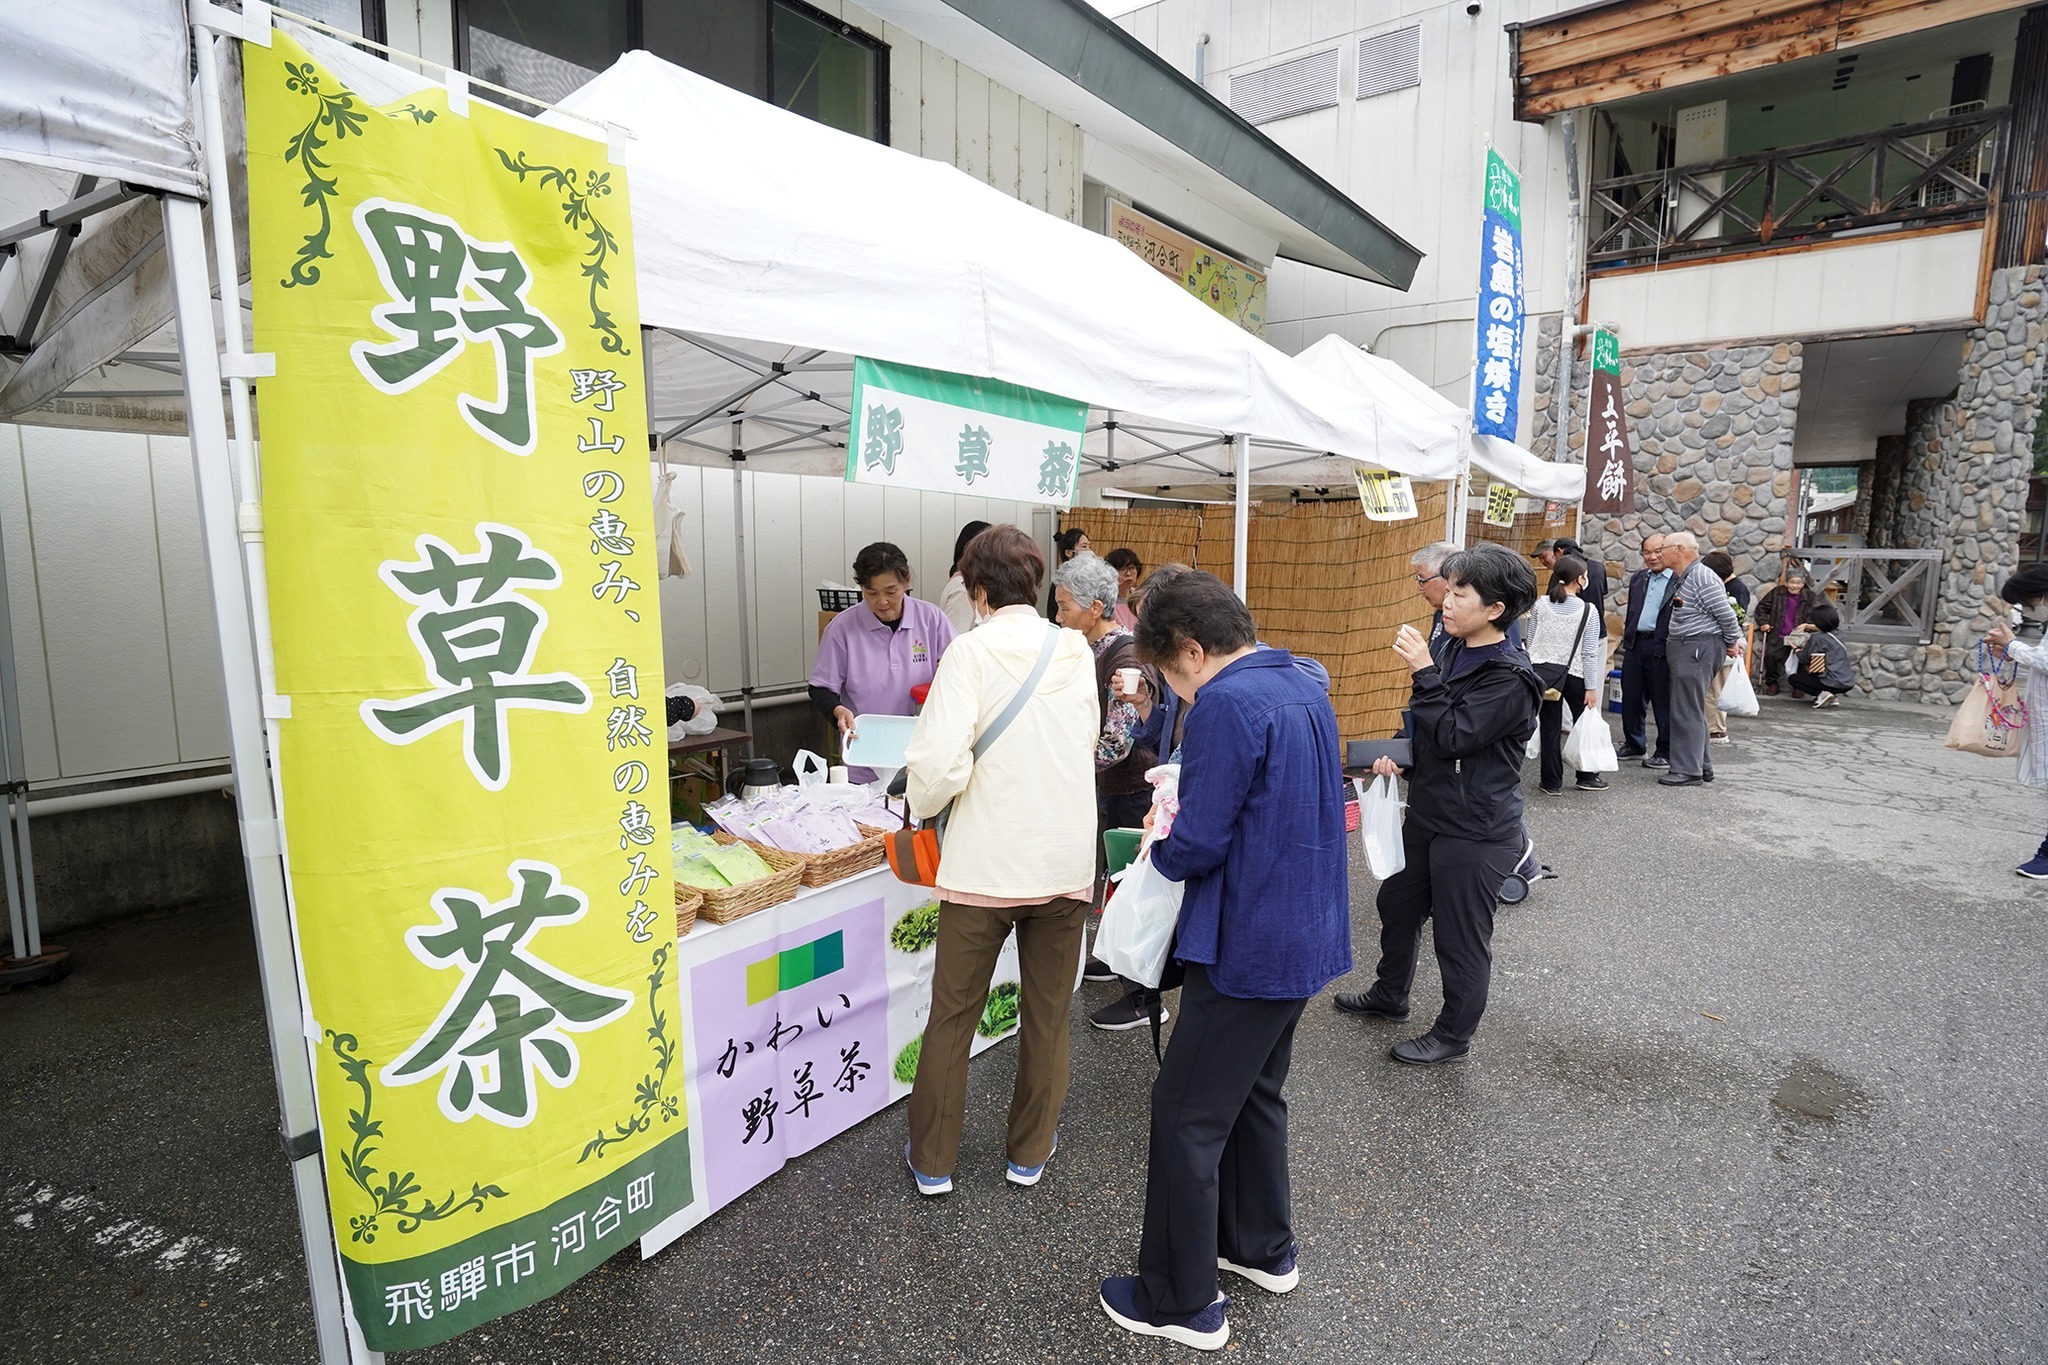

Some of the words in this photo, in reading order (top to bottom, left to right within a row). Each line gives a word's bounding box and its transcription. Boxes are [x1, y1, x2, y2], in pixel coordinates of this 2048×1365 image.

[1144, 239, 1179, 273] 河合町
[1483, 225, 1515, 424] 岩魚の塩焼き
[864, 402, 1075, 497] 野草茶
[1597, 383, 1628, 502] 五平餅
[350, 197, 634, 1128] 野草茶
[716, 993, 851, 1079] かわい
[741, 1040, 872, 1145] 野草茶
[551, 1171, 655, 1266] 河合町
